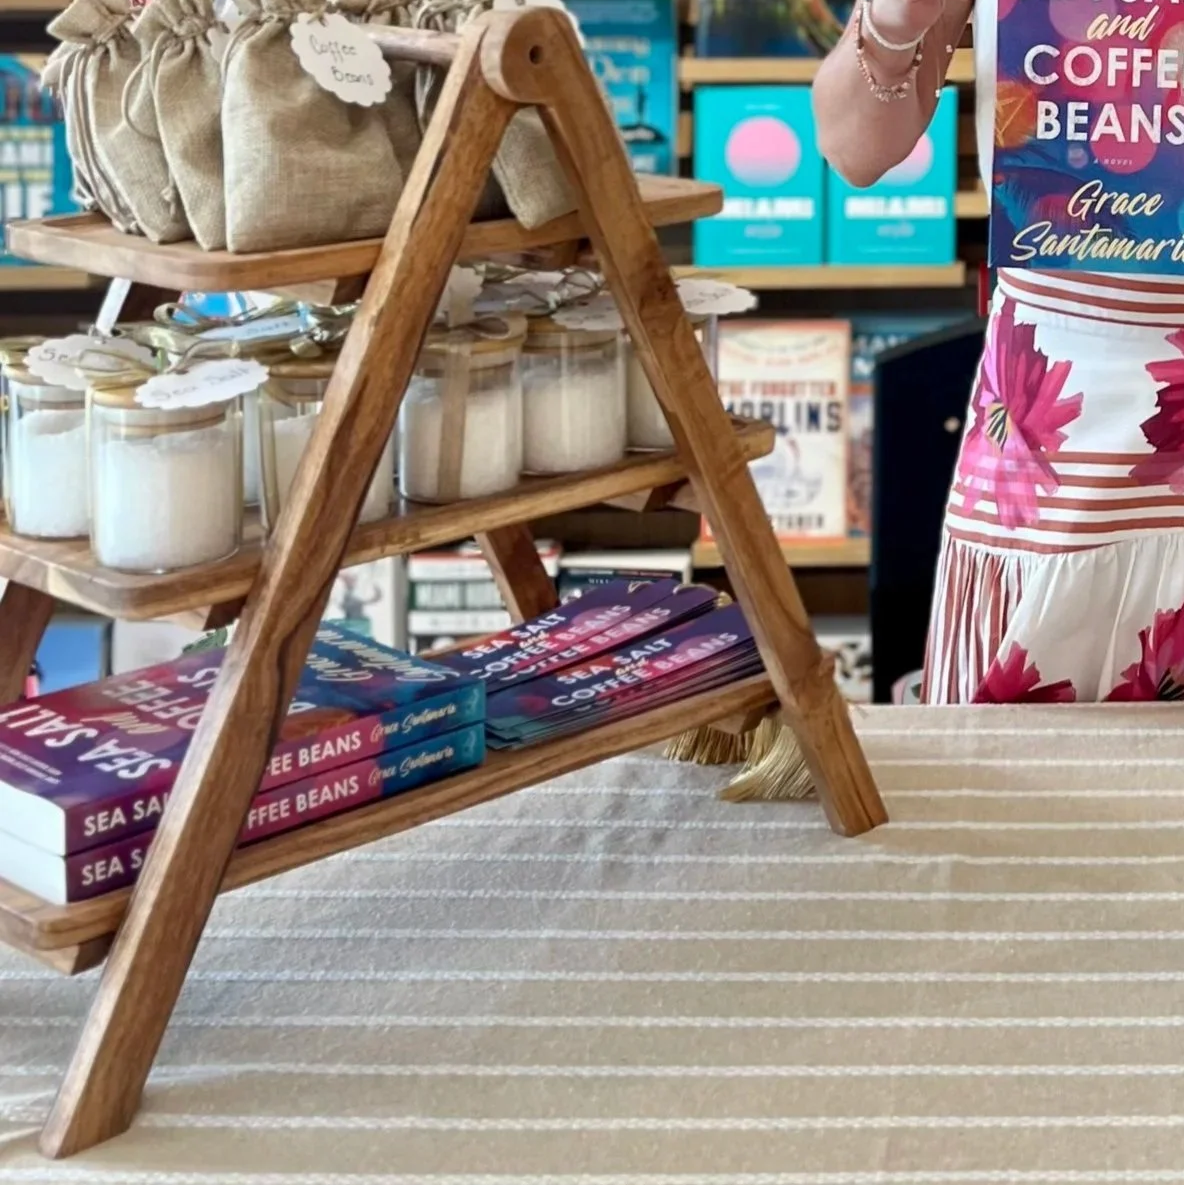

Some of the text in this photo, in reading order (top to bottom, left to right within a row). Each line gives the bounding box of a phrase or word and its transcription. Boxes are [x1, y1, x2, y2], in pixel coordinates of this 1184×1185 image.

[1087, 5, 1160, 41] and
[308, 34, 357, 61] Coffee
[330, 66, 375, 87] Beans
[1067, 180, 1165, 221] Grace
[462, 612, 567, 660] SEA SALT
[555, 604, 633, 642] BEANS
[591, 607, 671, 645] BEANS
[551, 632, 739, 708] COFFEE BEANS
[557, 637, 673, 685] SEA SALT
[77, 738, 172, 780] SEA
[298, 730, 361, 768] BEANS
[370, 720, 399, 743] Grace
[295, 775, 359, 813] BEANS
[367, 764, 397, 787] Grace
[84, 808, 126, 837] SEA
[81, 856, 124, 886] SEA
